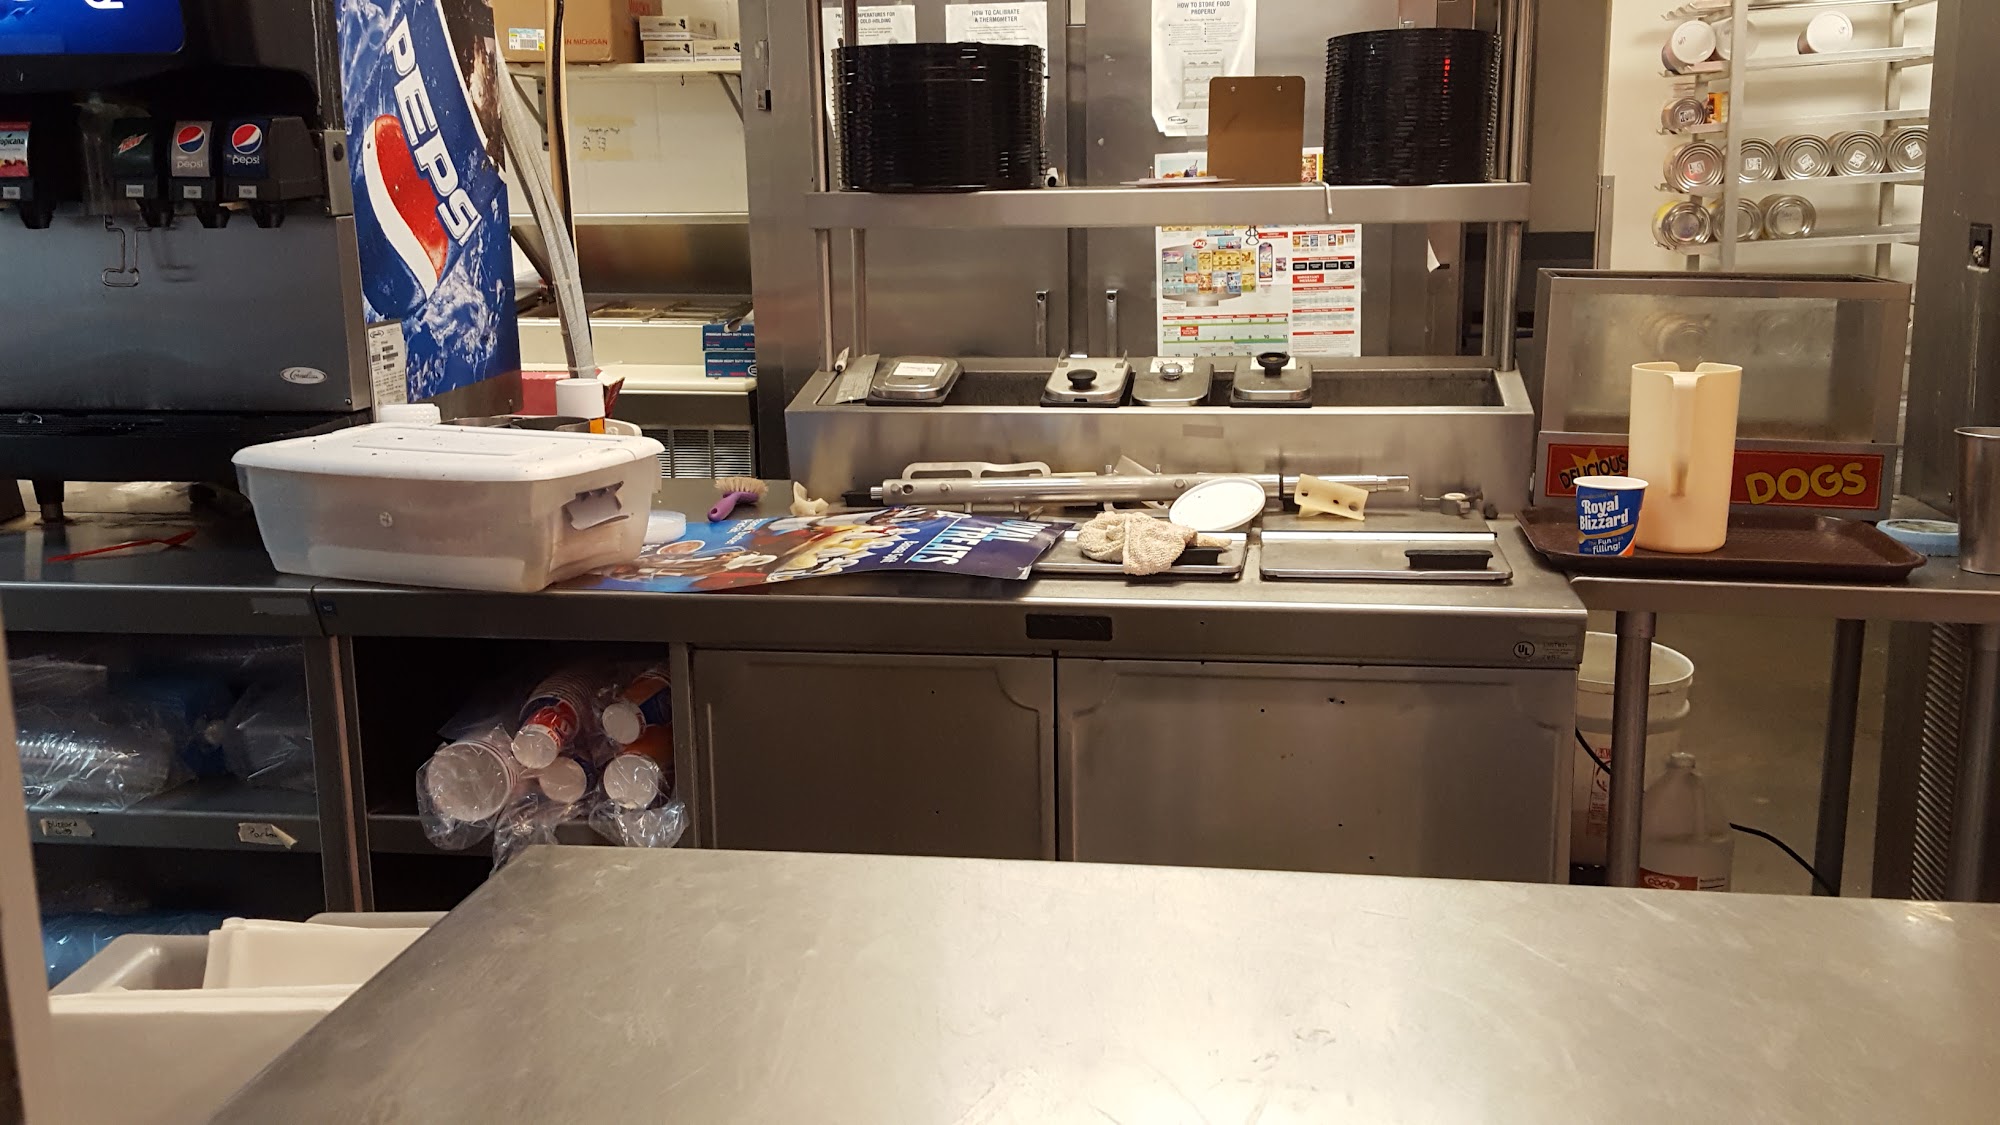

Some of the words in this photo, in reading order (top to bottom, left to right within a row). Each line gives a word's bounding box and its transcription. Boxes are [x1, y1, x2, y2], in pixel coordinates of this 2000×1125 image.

[385, 13, 483, 247] PEPSI
[177, 160, 203, 169] pepsi
[233, 154, 260, 165] pepsi
[1745, 462, 1867, 505] DOGS
[1581, 495, 1619, 517] Royal
[1579, 508, 1629, 530] Blizzard
[911, 525, 997, 565] TREATS
[1592, 541, 1621, 555] filling!
[1518, 644, 1530, 655] UL
